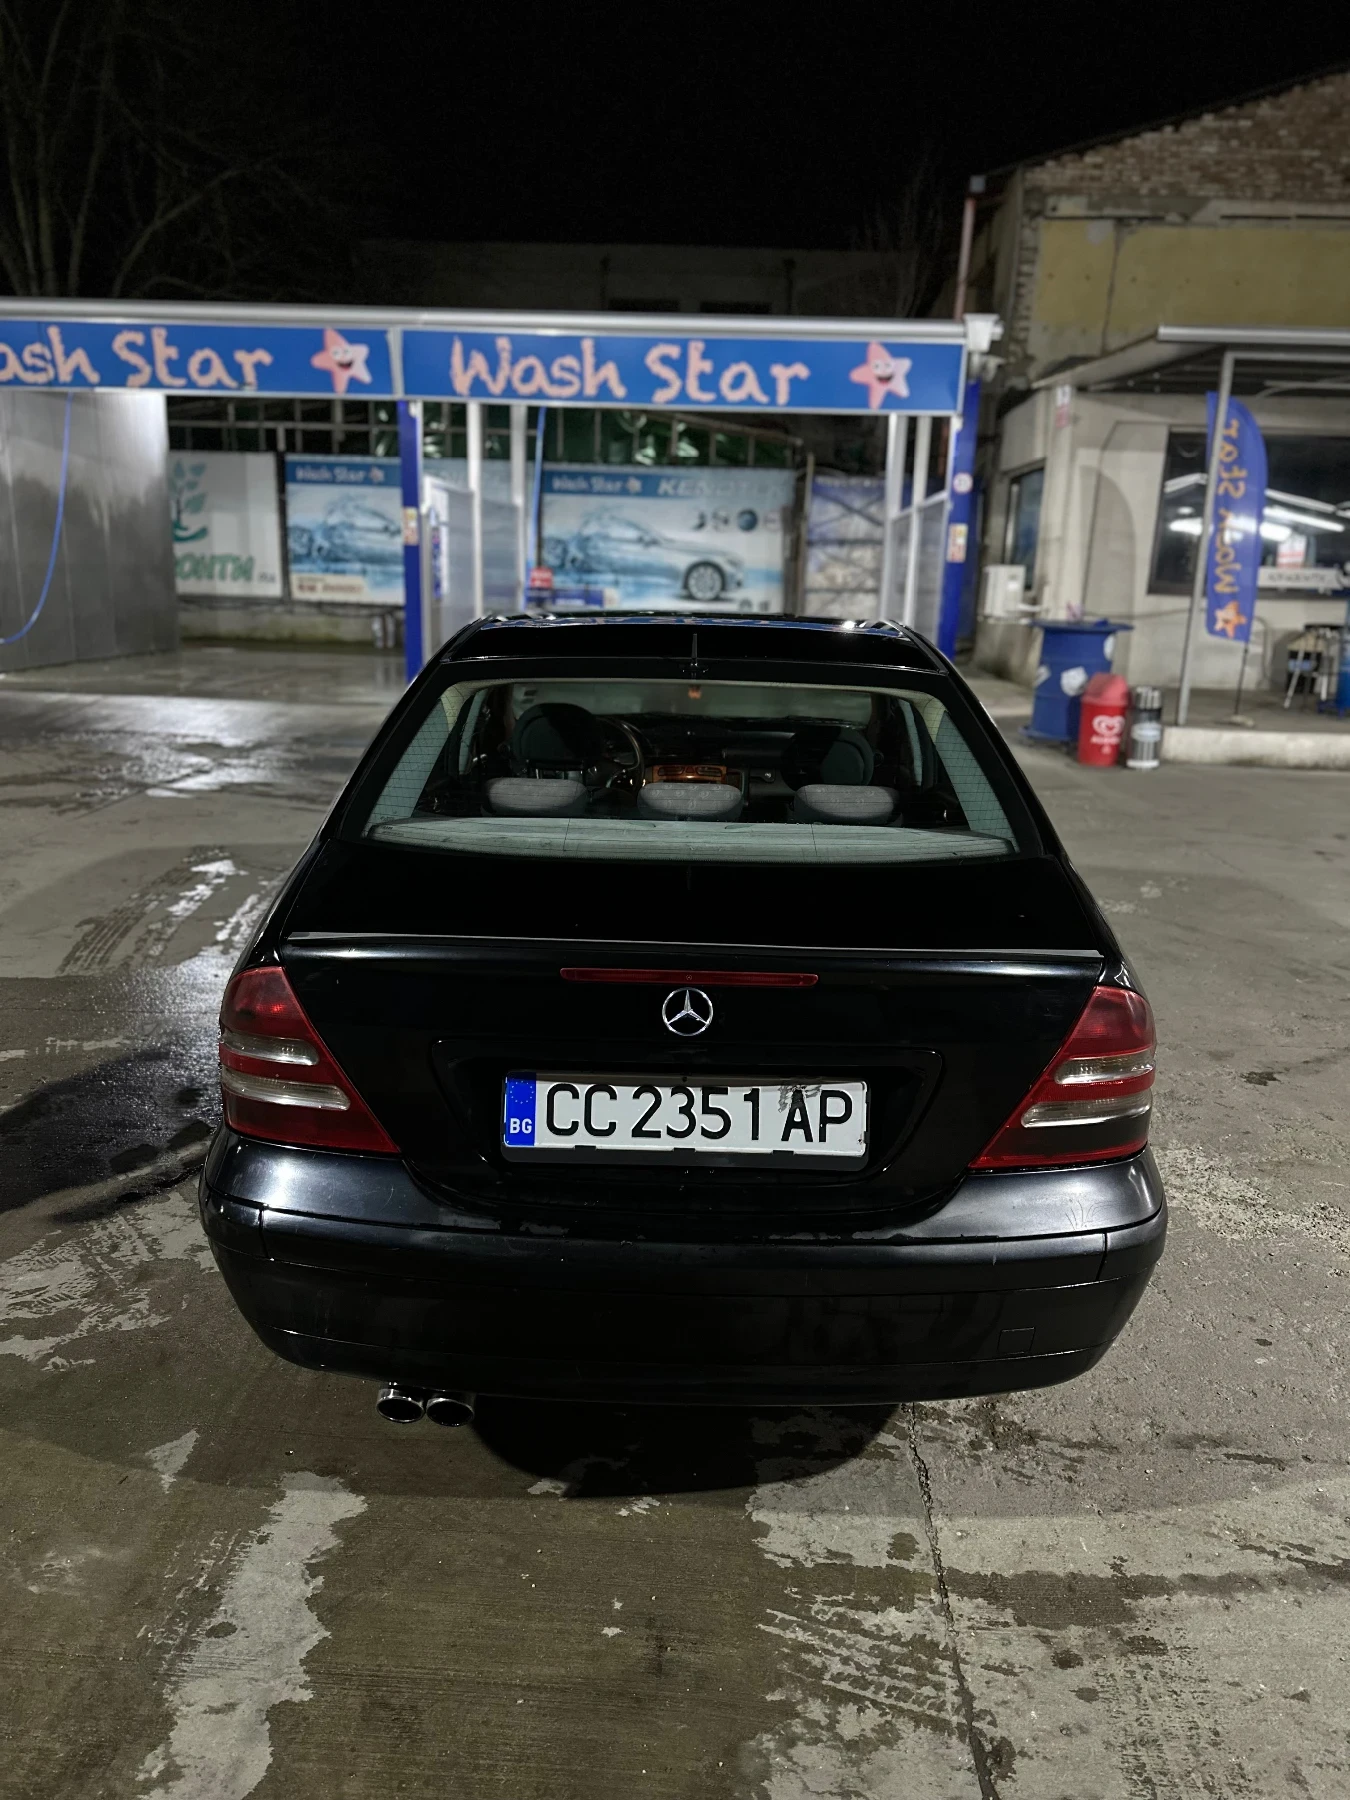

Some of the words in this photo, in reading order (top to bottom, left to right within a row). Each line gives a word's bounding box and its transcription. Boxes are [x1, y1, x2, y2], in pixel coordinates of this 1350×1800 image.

[0, 324, 100, 384] ash
[112, 326, 273, 389] Star
[451, 334, 628, 399] Wash
[644, 339, 812, 406] Star
[509, 1117, 533, 1134] BG
[545, 1083, 617, 1137] CC
[631, 1085, 761, 1141] 2351
[780, 1088, 853, 1143] AP
